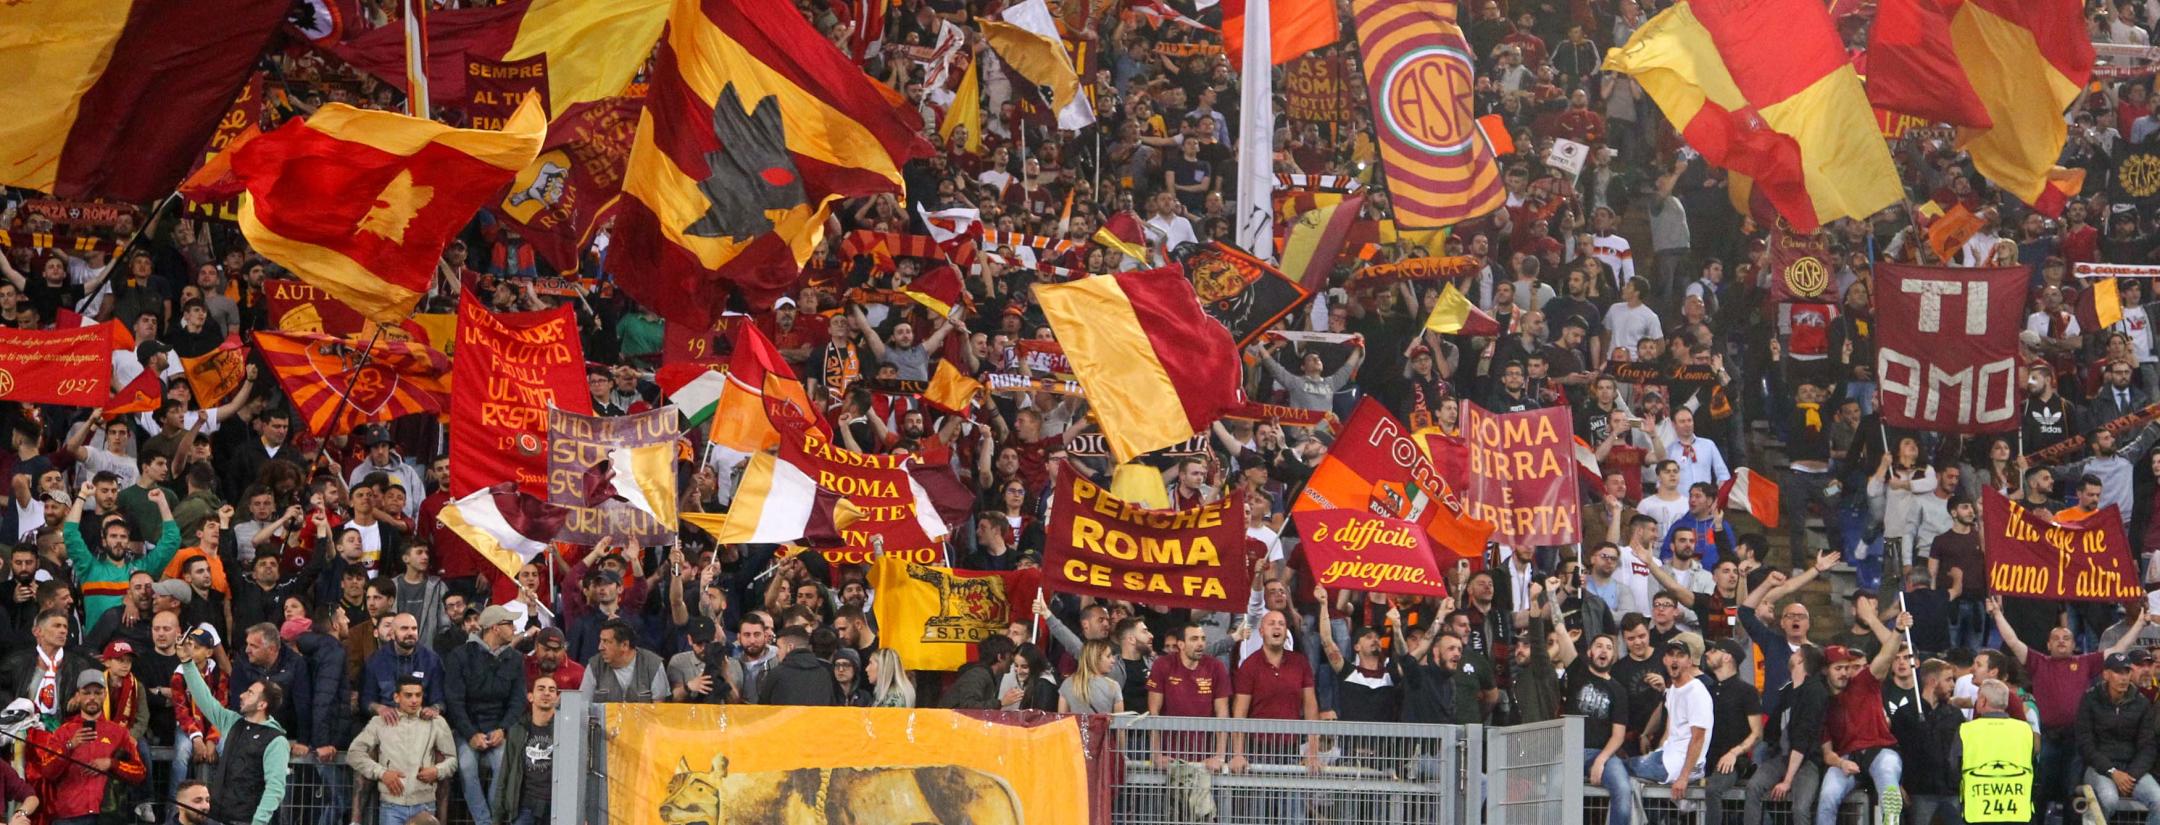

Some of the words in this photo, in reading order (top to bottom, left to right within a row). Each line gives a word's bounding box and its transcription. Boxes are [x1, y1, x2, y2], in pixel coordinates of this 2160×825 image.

[469, 63, 543, 79] SEMPRE
[1299, 60, 1327, 76] AS
[474, 91, 497, 105] AL
[1288, 73, 1349, 95] ROMA
[1397, 61, 1473, 141] ASR
[83, 205, 118, 219] ROMA
[540, 185, 578, 229] ROMA
[1397, 259, 1460, 277] ROMA
[1901, 278, 1989, 335] TI
[57, 379, 98, 396] 1927
[1878, 347, 2015, 425] AMO
[1263, 404, 1309, 419] ROMA
[1471, 409, 1559, 448] ROMA
[803, 435, 880, 470] PASSA
[1471, 448, 1563, 481] BIRRA
[820, 471, 899, 498] ROMA
[1502, 487, 1514, 504] E
[1073, 477, 1231, 530] PERCHE'
[1072, 515, 1221, 567] ROMA
[1313, 522, 1328, 542] è
[1334, 518, 1417, 551] difficile
[2083, 530, 2107, 553] ne
[1063, 559, 1112, 587] CE
[1123, 572, 1172, 594] SA
[1182, 576, 1227, 599] FA
[1320, 555, 1442, 587] spiegare...
[1983, 799, 2017, 816] 244
